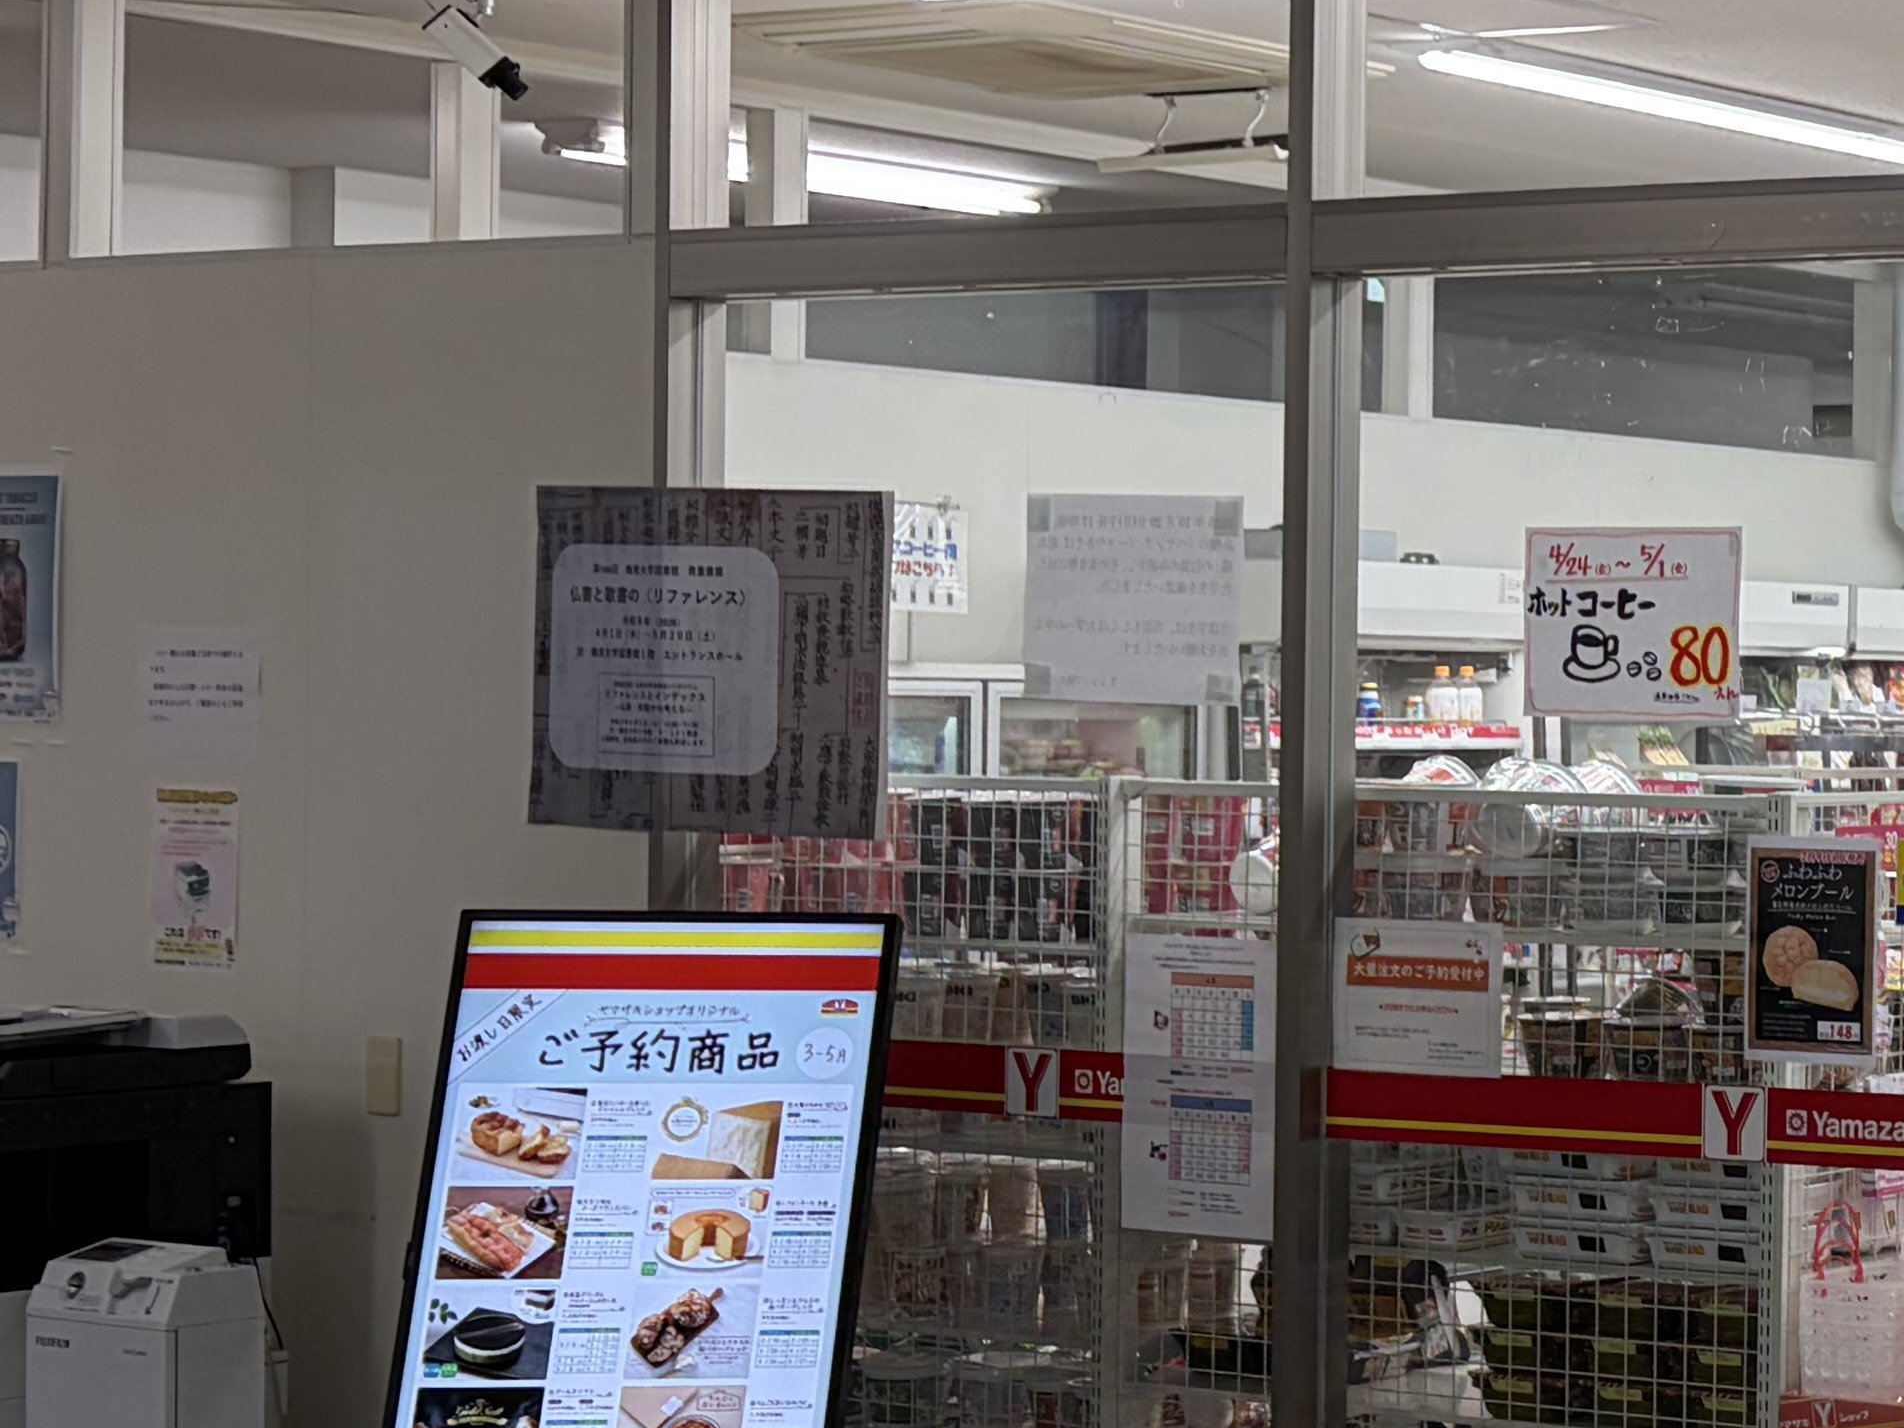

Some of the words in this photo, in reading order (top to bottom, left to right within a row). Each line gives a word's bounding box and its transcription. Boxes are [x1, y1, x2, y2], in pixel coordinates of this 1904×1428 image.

[1670, 625, 1729, 686] 80
[538, 1029, 781, 1075] ご予約商品
[1829, 1024, 1853, 1040] 148
[1013, 1052, 1053, 1112] Y
[1096, 1071, 1124, 1096] Ya
[1712, 1091, 1757, 1156] Y
